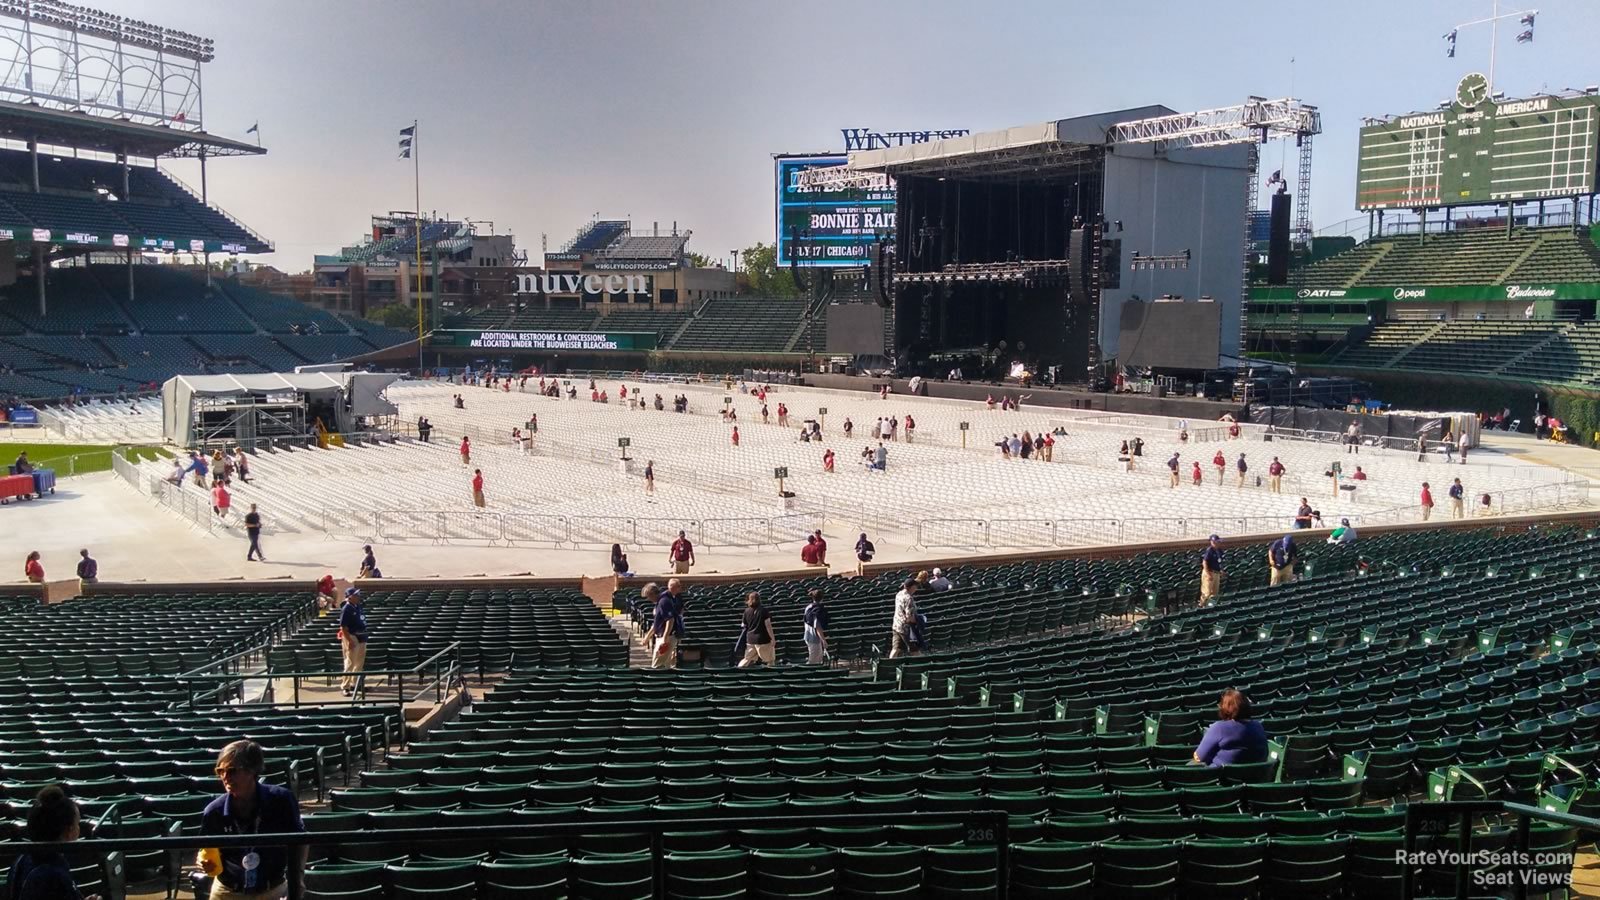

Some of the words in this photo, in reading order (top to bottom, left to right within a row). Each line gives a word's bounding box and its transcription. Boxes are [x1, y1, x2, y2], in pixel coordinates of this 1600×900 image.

[1495, 98, 1549, 116] AMERICAN
[1400, 113, 1446, 128] NATIONAL
[811, 214, 860, 228] BONNIE
[788, 246, 810, 256] JLY
[812, 246, 821, 256] 17
[827, 246, 863, 256] CHICAGO
[516, 274, 648, 294] nuveen
[1404, 289, 1425, 298] pepsi
[1506, 286, 1556, 298] Budweiser
[968, 829, 994, 840] 236
